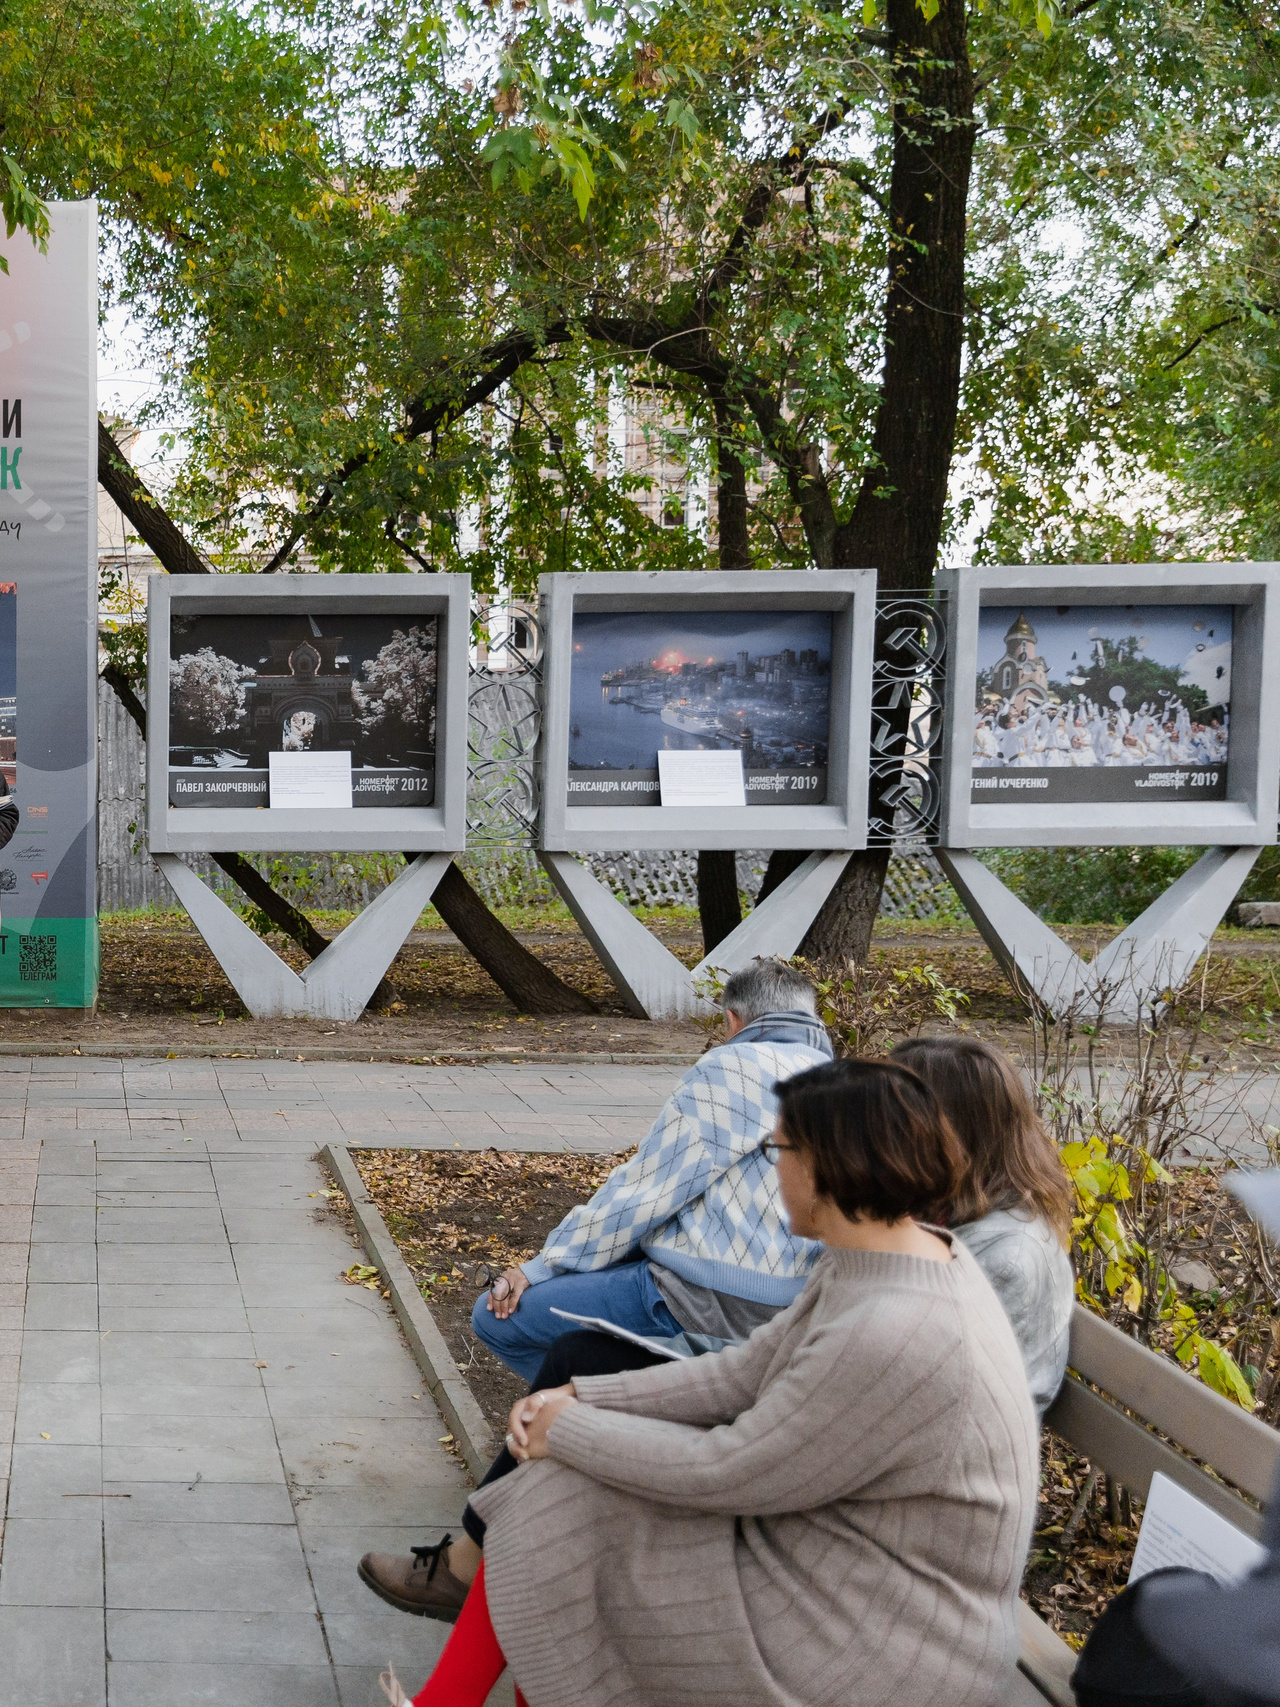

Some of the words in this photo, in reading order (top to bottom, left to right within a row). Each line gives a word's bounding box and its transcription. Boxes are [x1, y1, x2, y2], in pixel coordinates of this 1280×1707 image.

[359, 777, 400, 785] HOMEPORT
[401, 777, 428, 791] 2012
[790, 775, 818, 790] 2019
[970, 776, 998, 789] ГЕНИЙ
[999, 777, 1049, 789] КУЧЕРЕНКО
[1134, 779, 1186, 787] VLADIVOSTOK
[1148, 772, 1190, 780] HOMEPORT
[1190, 772, 1219, 786] 2019
[176, 782, 204, 793] ПАВЕЛ
[205, 780, 267, 793] ЗАКОРЧЕВНЫЙ
[352, 784, 396, 792] LADIVOSTOK
[620, 781, 660, 793] КАРПЦОВ
[19, 971, 57, 981] ТЕЛЕГРАМ
